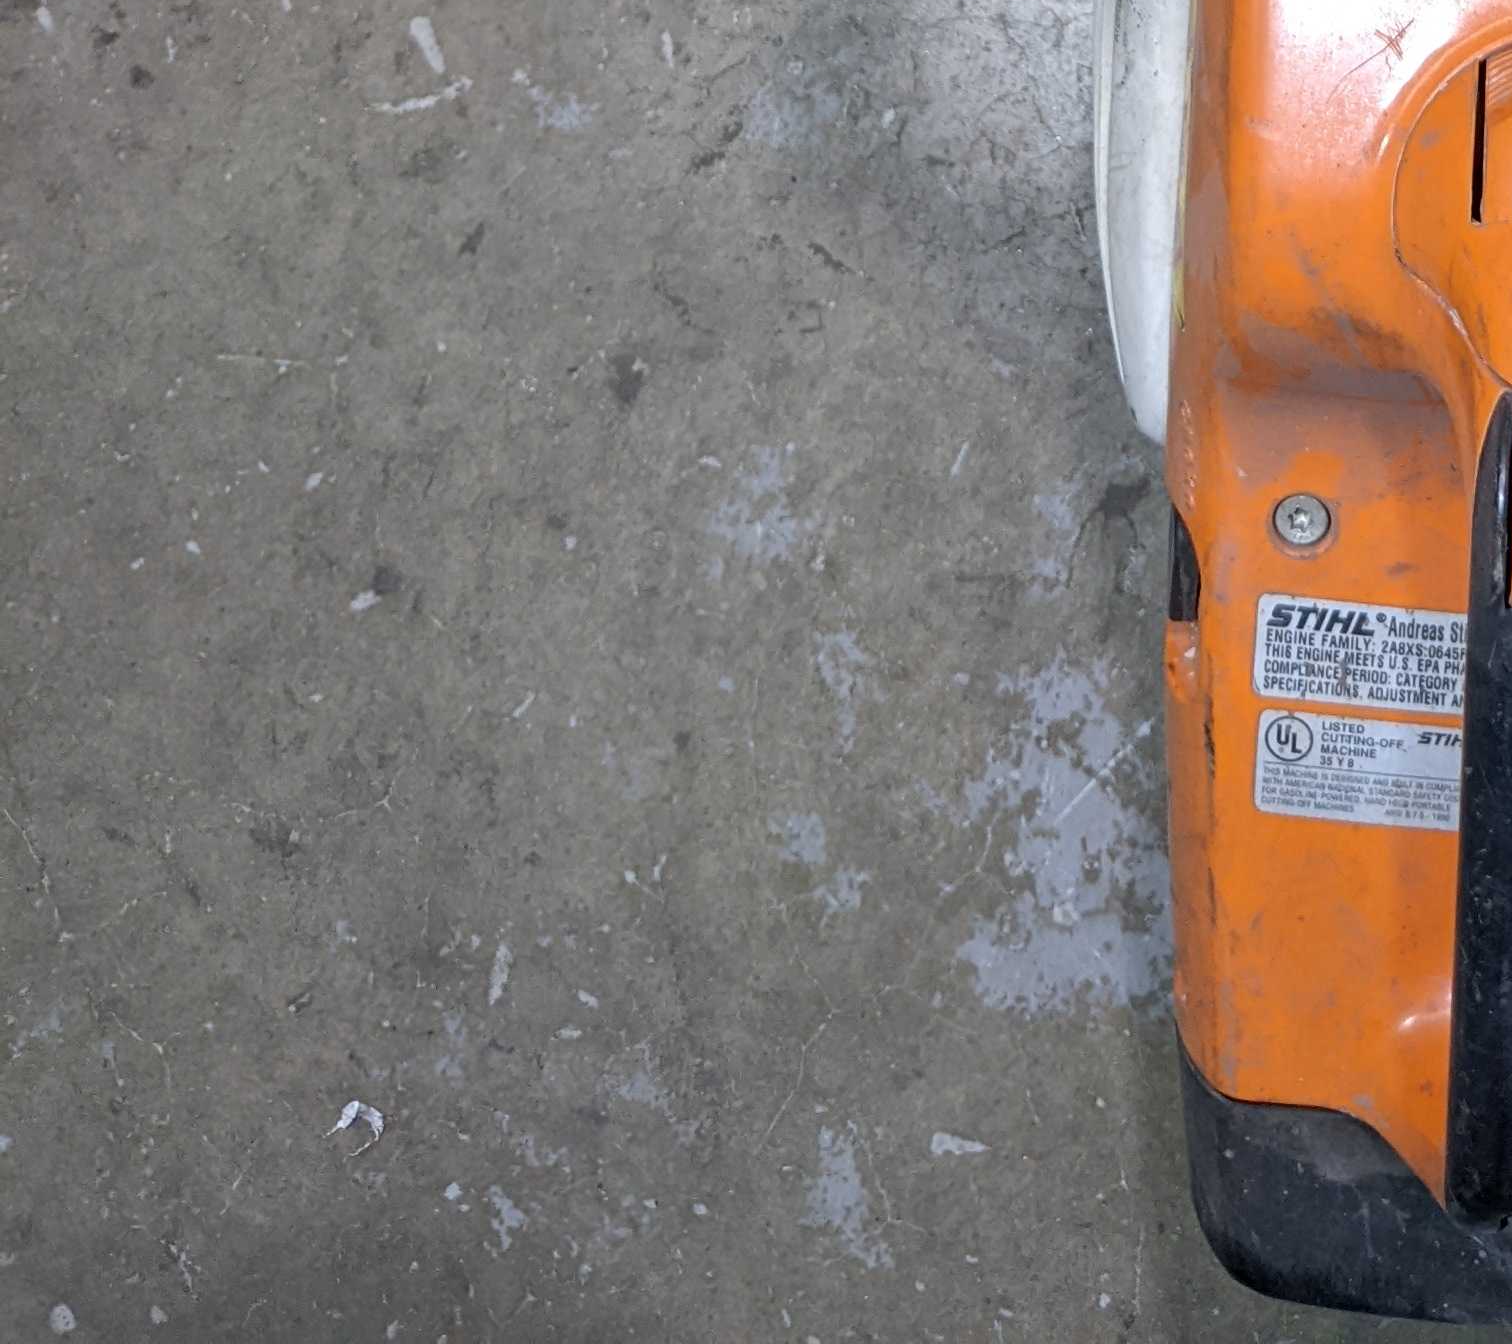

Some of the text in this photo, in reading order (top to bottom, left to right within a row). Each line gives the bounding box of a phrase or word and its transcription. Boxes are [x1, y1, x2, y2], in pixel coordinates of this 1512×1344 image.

[1388, 615, 1445, 642] Andreas
[1266, 628, 1315, 646] ENGINE
[1321, 634, 1375, 652] FAMILY:
[1265, 643, 1292, 659] THIS
[1297, 646, 1340, 664] ENGINE
[1344, 651, 1384, 668] MEETS
[1417, 658, 1440, 673] EPA
[1345, 667, 1391, 685] PERIOD:
[1396, 672, 1457, 691] CATEGORY
[1368, 686, 1447, 706] ADJUSTMENT
[1321, 720, 1365, 733] LISTED
[1321, 732, 1404, 749] CUTTING-OFF
[1417, 731, 1462, 747] STIH
[1320, 744, 1377, 759] MACHINE
